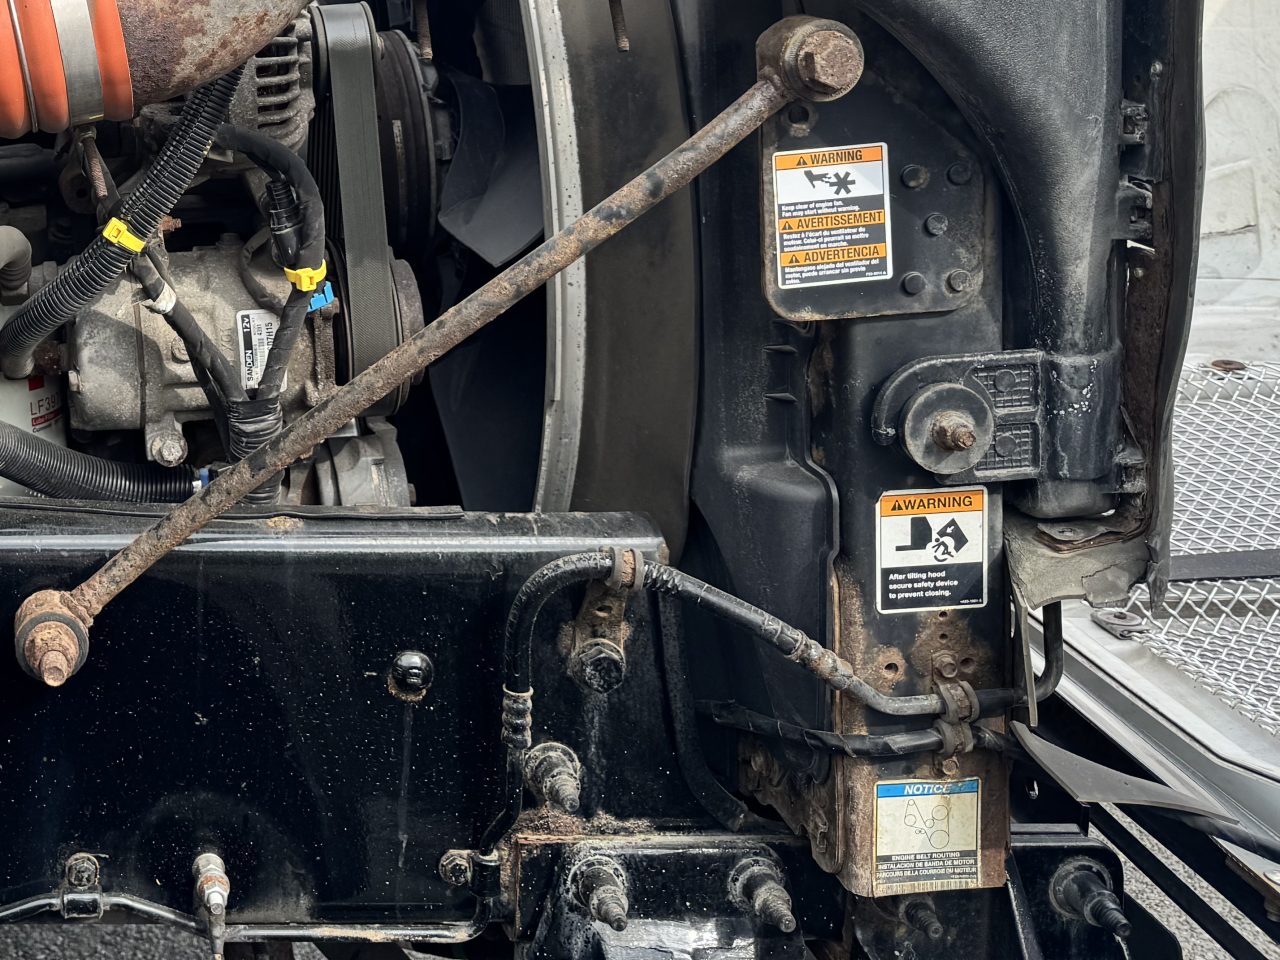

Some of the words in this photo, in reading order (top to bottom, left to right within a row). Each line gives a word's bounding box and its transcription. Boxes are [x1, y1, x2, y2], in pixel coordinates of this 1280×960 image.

[810, 150, 863, 165] WARNING
[797, 211, 883, 230] AVERTISSEMENT
[803, 245, 880, 263] ADVERTENCIA
[245, 349, 254, 382] SANDEN
[903, 495, 973, 510] WARNING
[907, 572, 926, 580] tilting
[928, 570, 946, 578] hood
[935, 579, 959, 587] device
[897, 591, 924, 599] prevent
[925, 589, 952, 597] closing.
[904, 783, 952, 795] NOTICE
[932, 851, 961, 859] ROUTING
